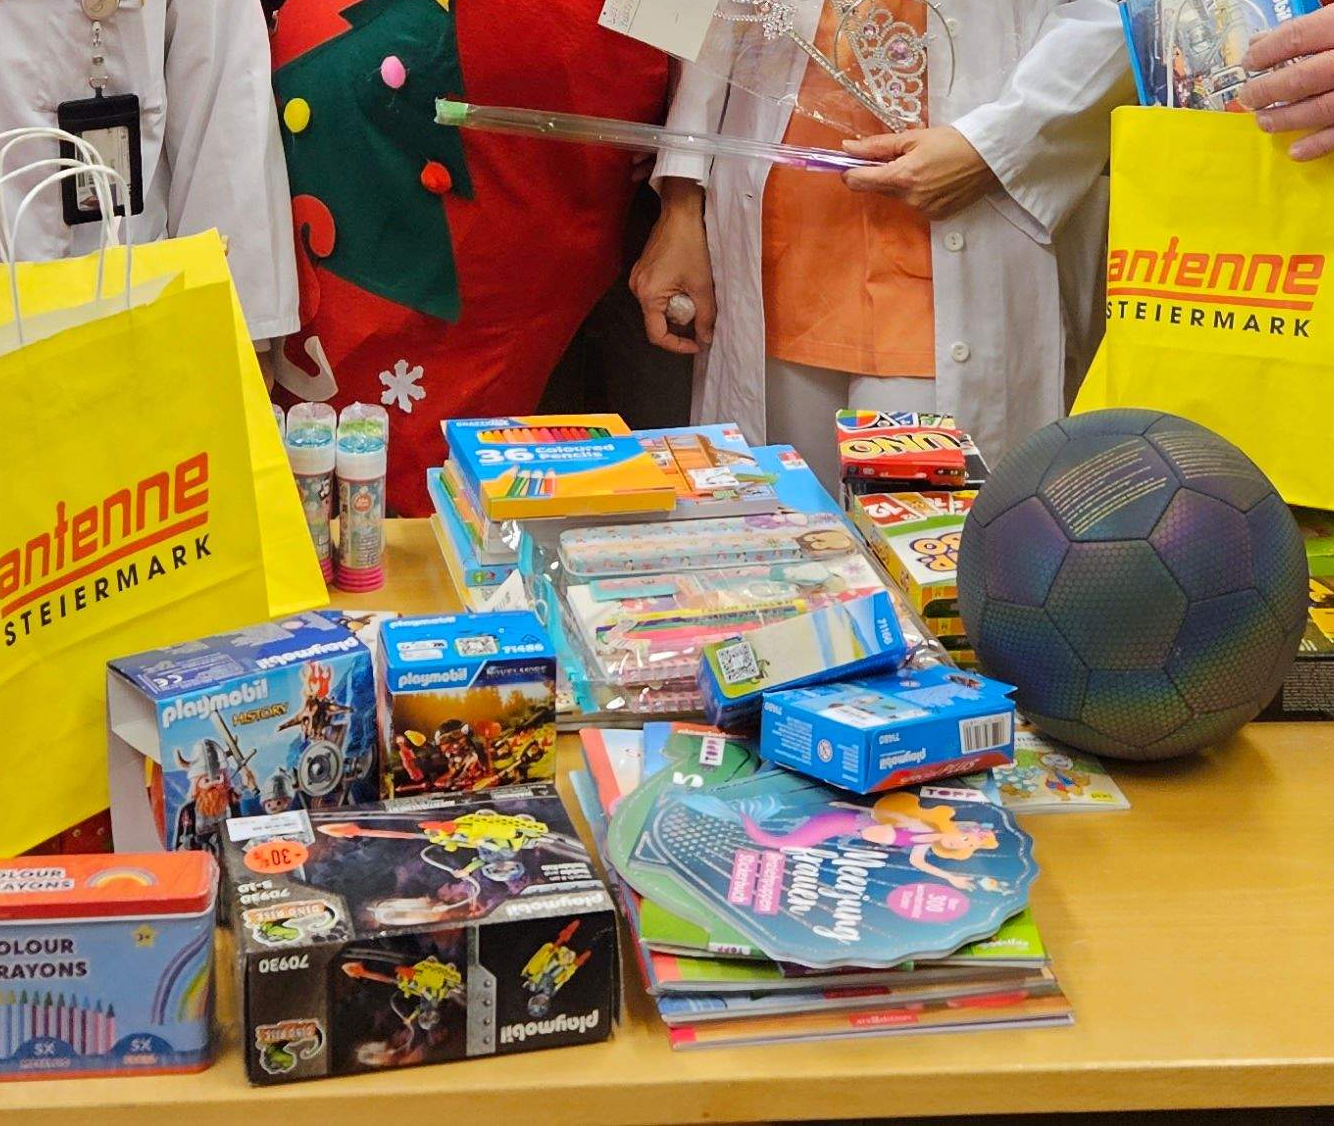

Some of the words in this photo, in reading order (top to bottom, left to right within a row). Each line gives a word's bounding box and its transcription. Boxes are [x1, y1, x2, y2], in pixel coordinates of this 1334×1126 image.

[1107, 235, 1326, 297] antenne
[1105, 300, 1312, 338] STEIERMARK
[474, 447, 527, 465] 36
[534, 443, 615, 455] Coloured
[841, 430, 949, 459] UNO
[3, 533, 213, 647] STEIERMARK
[256, 635, 360, 670] playmobil
[397, 669, 469, 689] playmobil
[161, 677, 268, 729] playmobil
[230, 703, 290, 728] HISTORY
[878, 746, 927, 771] playmobil
[927, 788, 978, 799] TOPP
[781, 846, 838, 915] frauen
[813, 847, 887, 944] Meerjung
[504, 892, 605, 918] playmobil
[258, 955, 309, 974] 70930
[499, 1009, 599, 1044] playmobil
